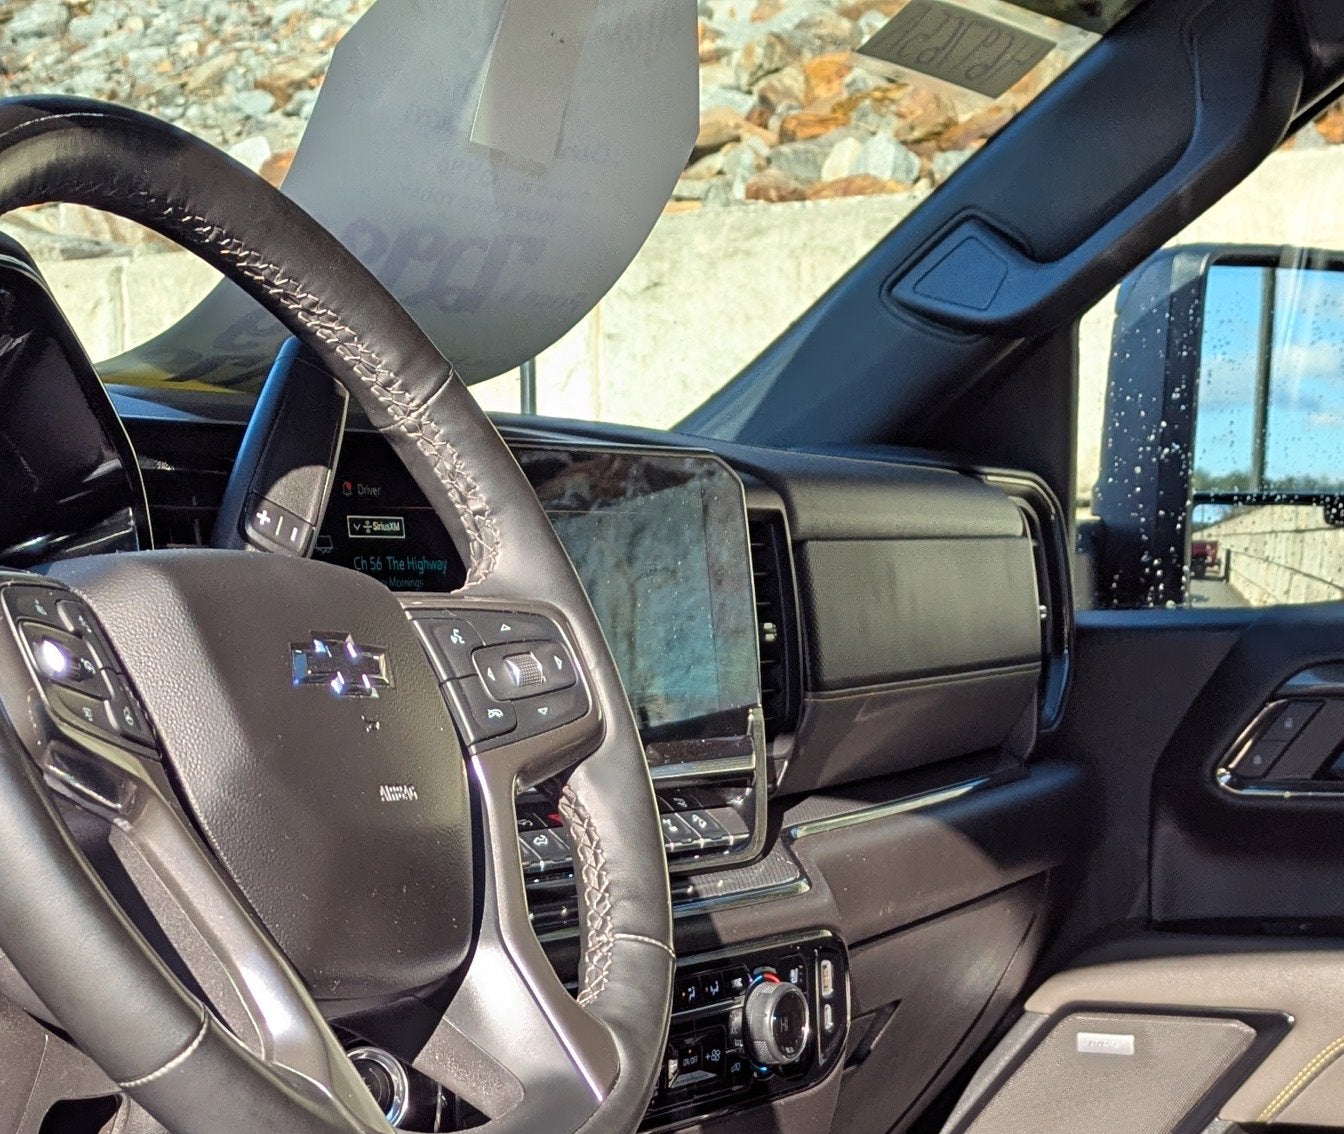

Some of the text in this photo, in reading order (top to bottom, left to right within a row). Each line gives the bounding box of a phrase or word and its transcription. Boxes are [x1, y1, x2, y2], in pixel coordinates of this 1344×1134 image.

[357, 484, 382, 496] Driver
[354, 556, 448, 575] Ch 56 The Highway
